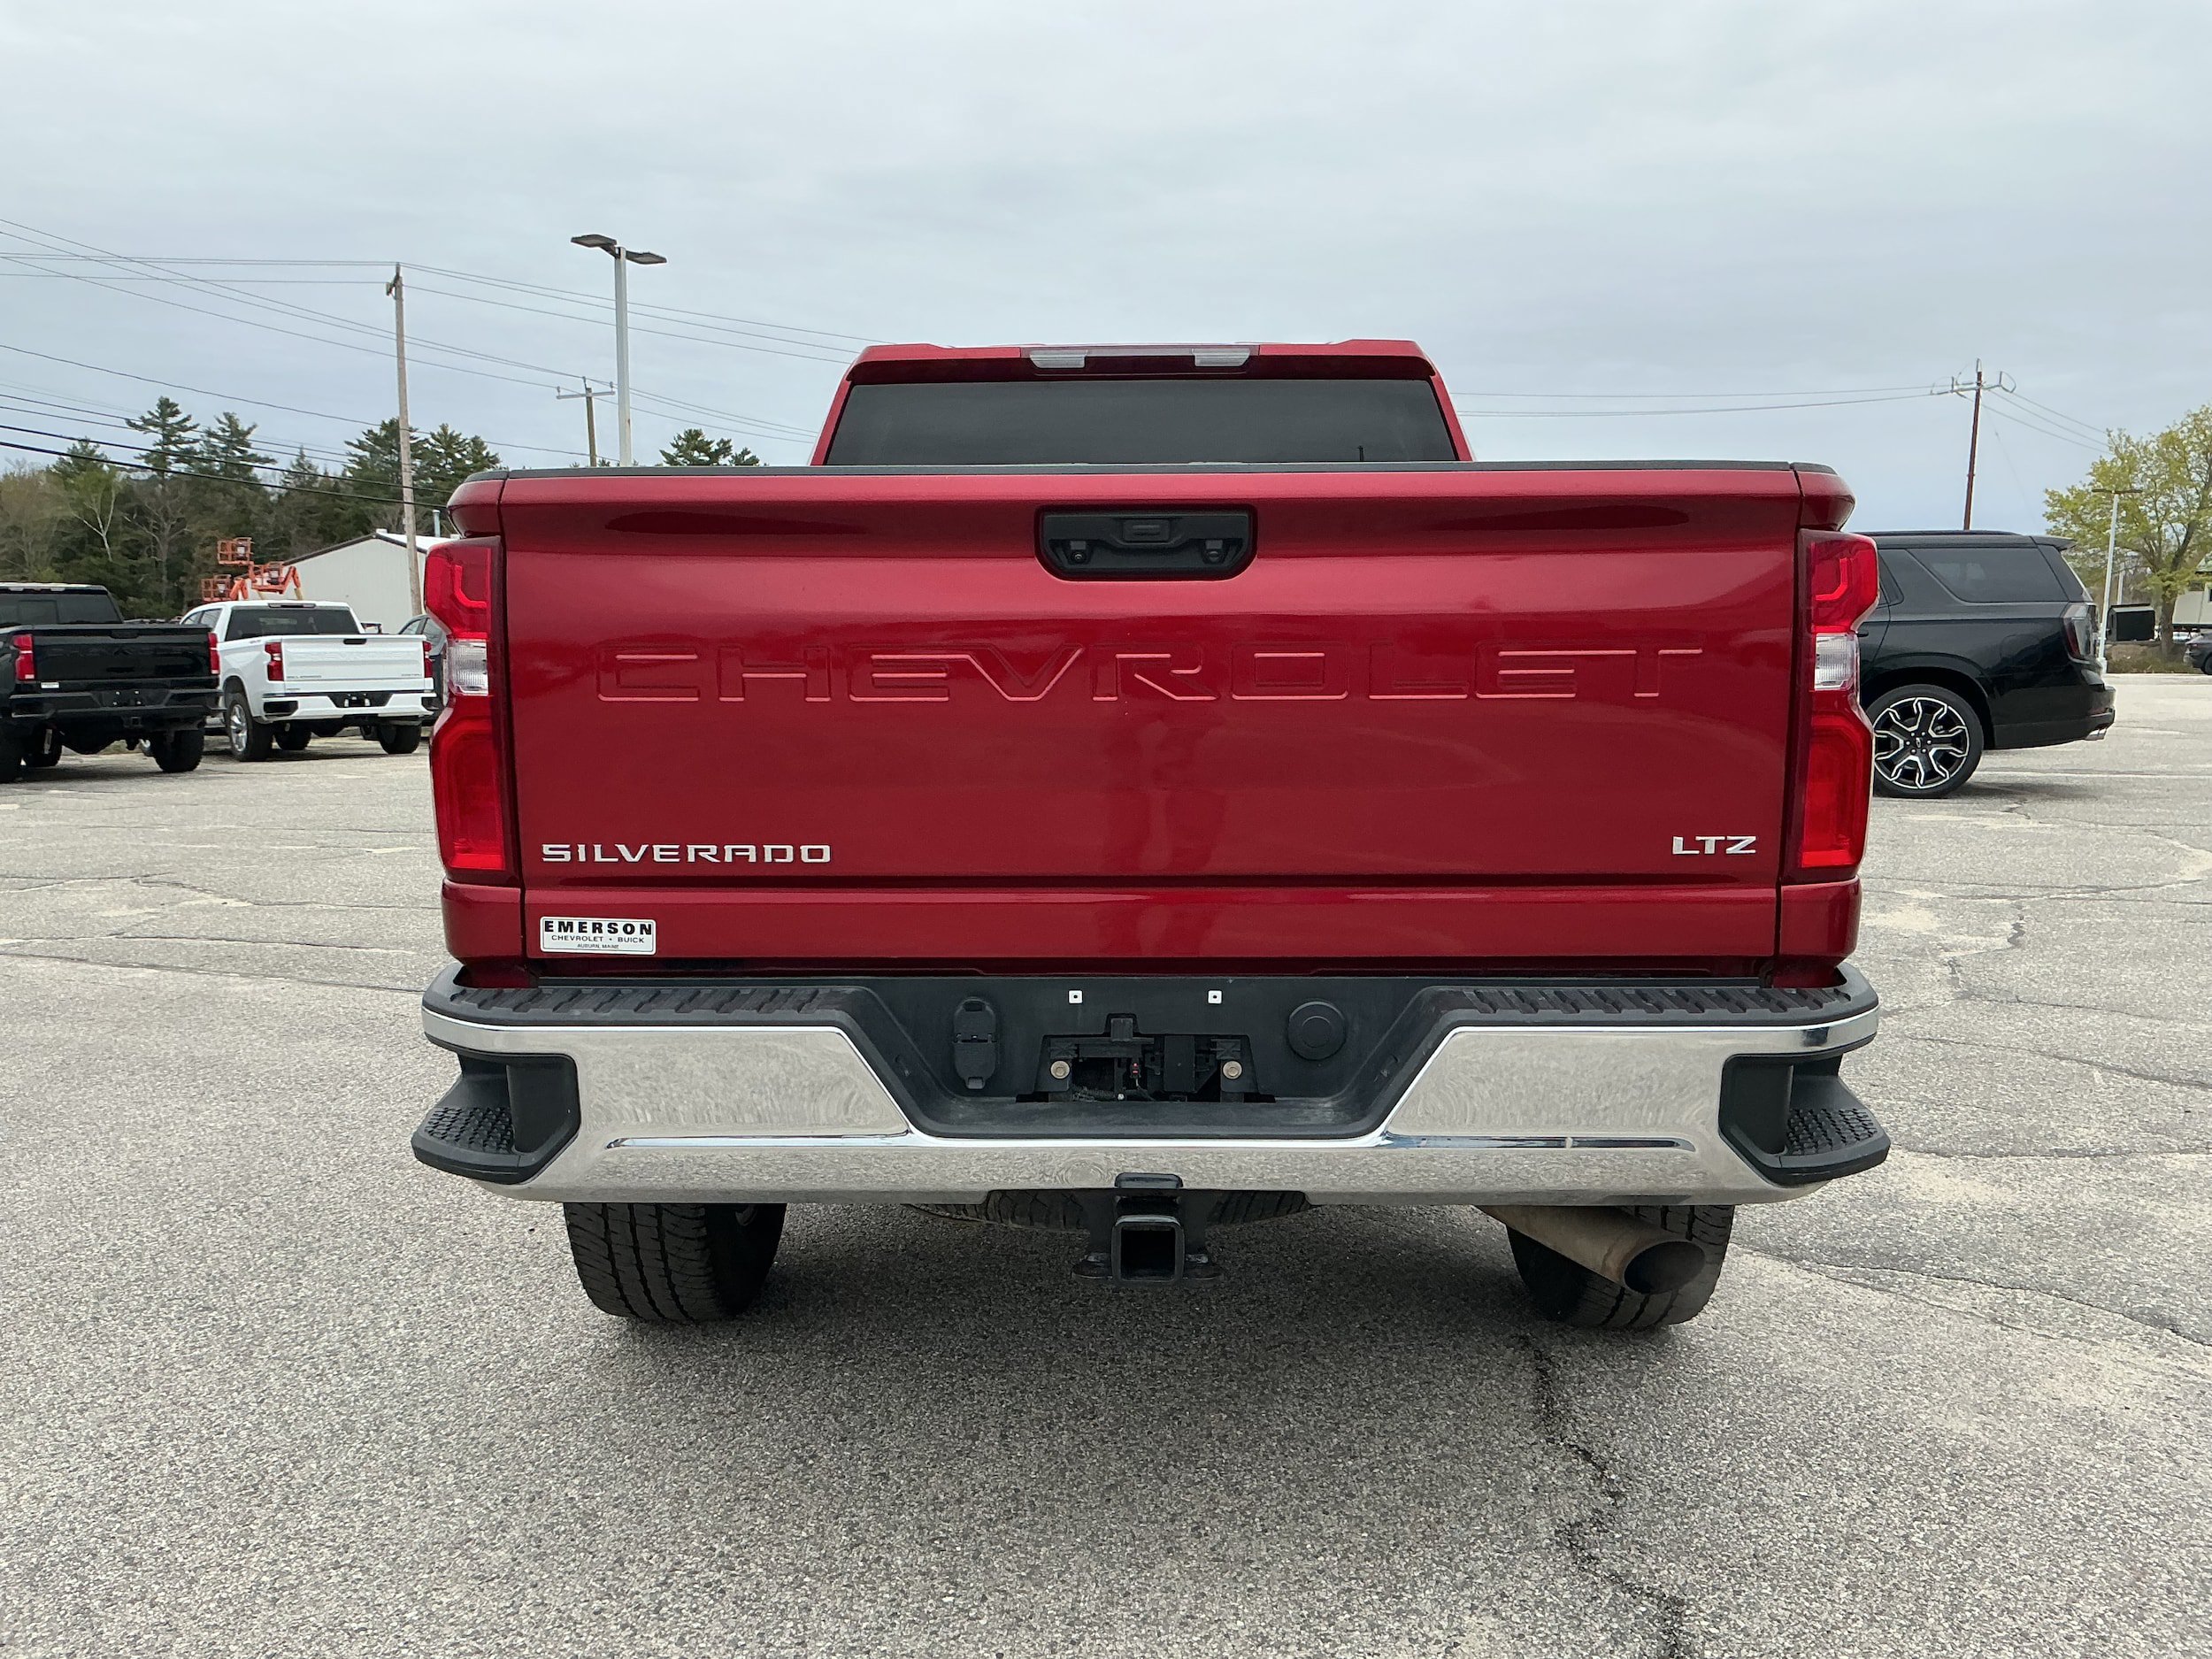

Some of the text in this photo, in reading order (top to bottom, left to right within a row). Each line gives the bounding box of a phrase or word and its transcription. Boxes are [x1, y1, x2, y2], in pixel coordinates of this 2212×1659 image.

[595, 643, 1703, 702] CHEVROLET
[541, 843, 832, 864] SILVERADO
[1671, 835, 1757, 855] LTZ
[544, 920, 652, 935] EMERSON
